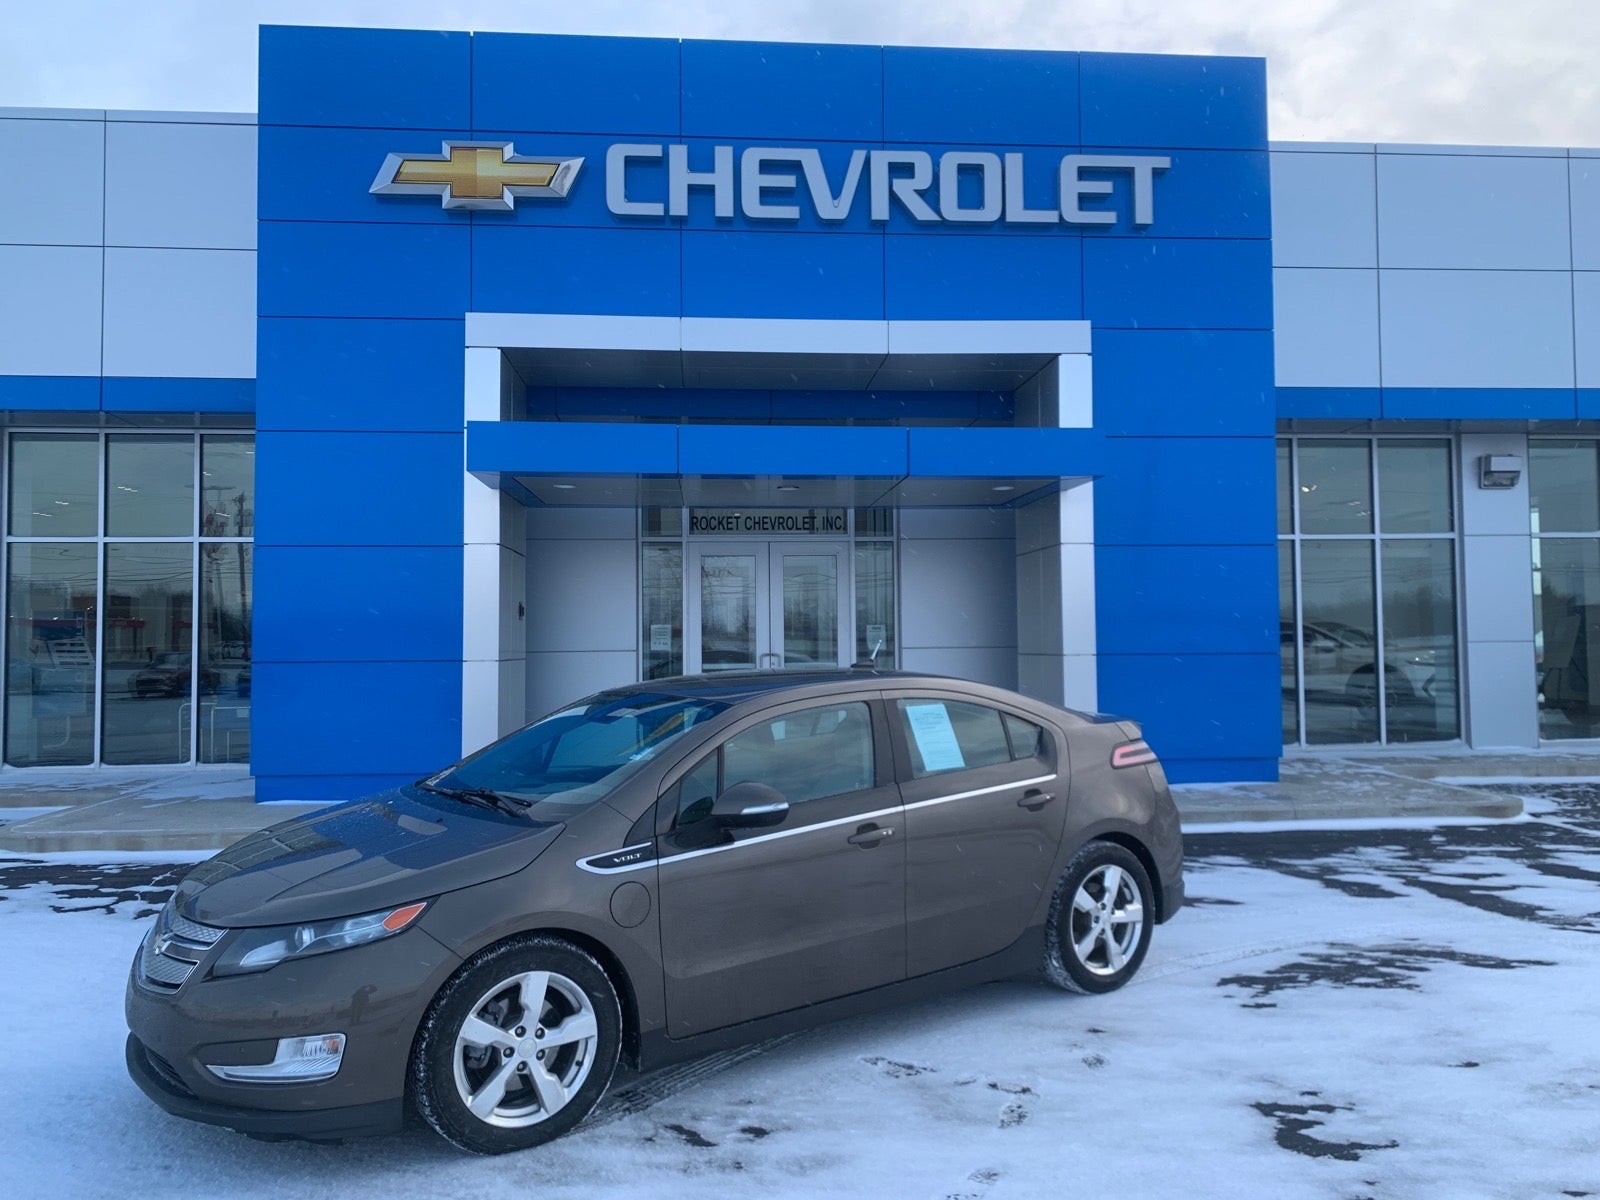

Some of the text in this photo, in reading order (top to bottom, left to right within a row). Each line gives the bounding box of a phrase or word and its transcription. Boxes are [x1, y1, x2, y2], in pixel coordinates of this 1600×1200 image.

[605, 143, 1172, 227] CHEVROLET
[691, 515, 845, 532] ROCKET CHEVROLET, INC.
[613, 852, 642, 863] VOLT
